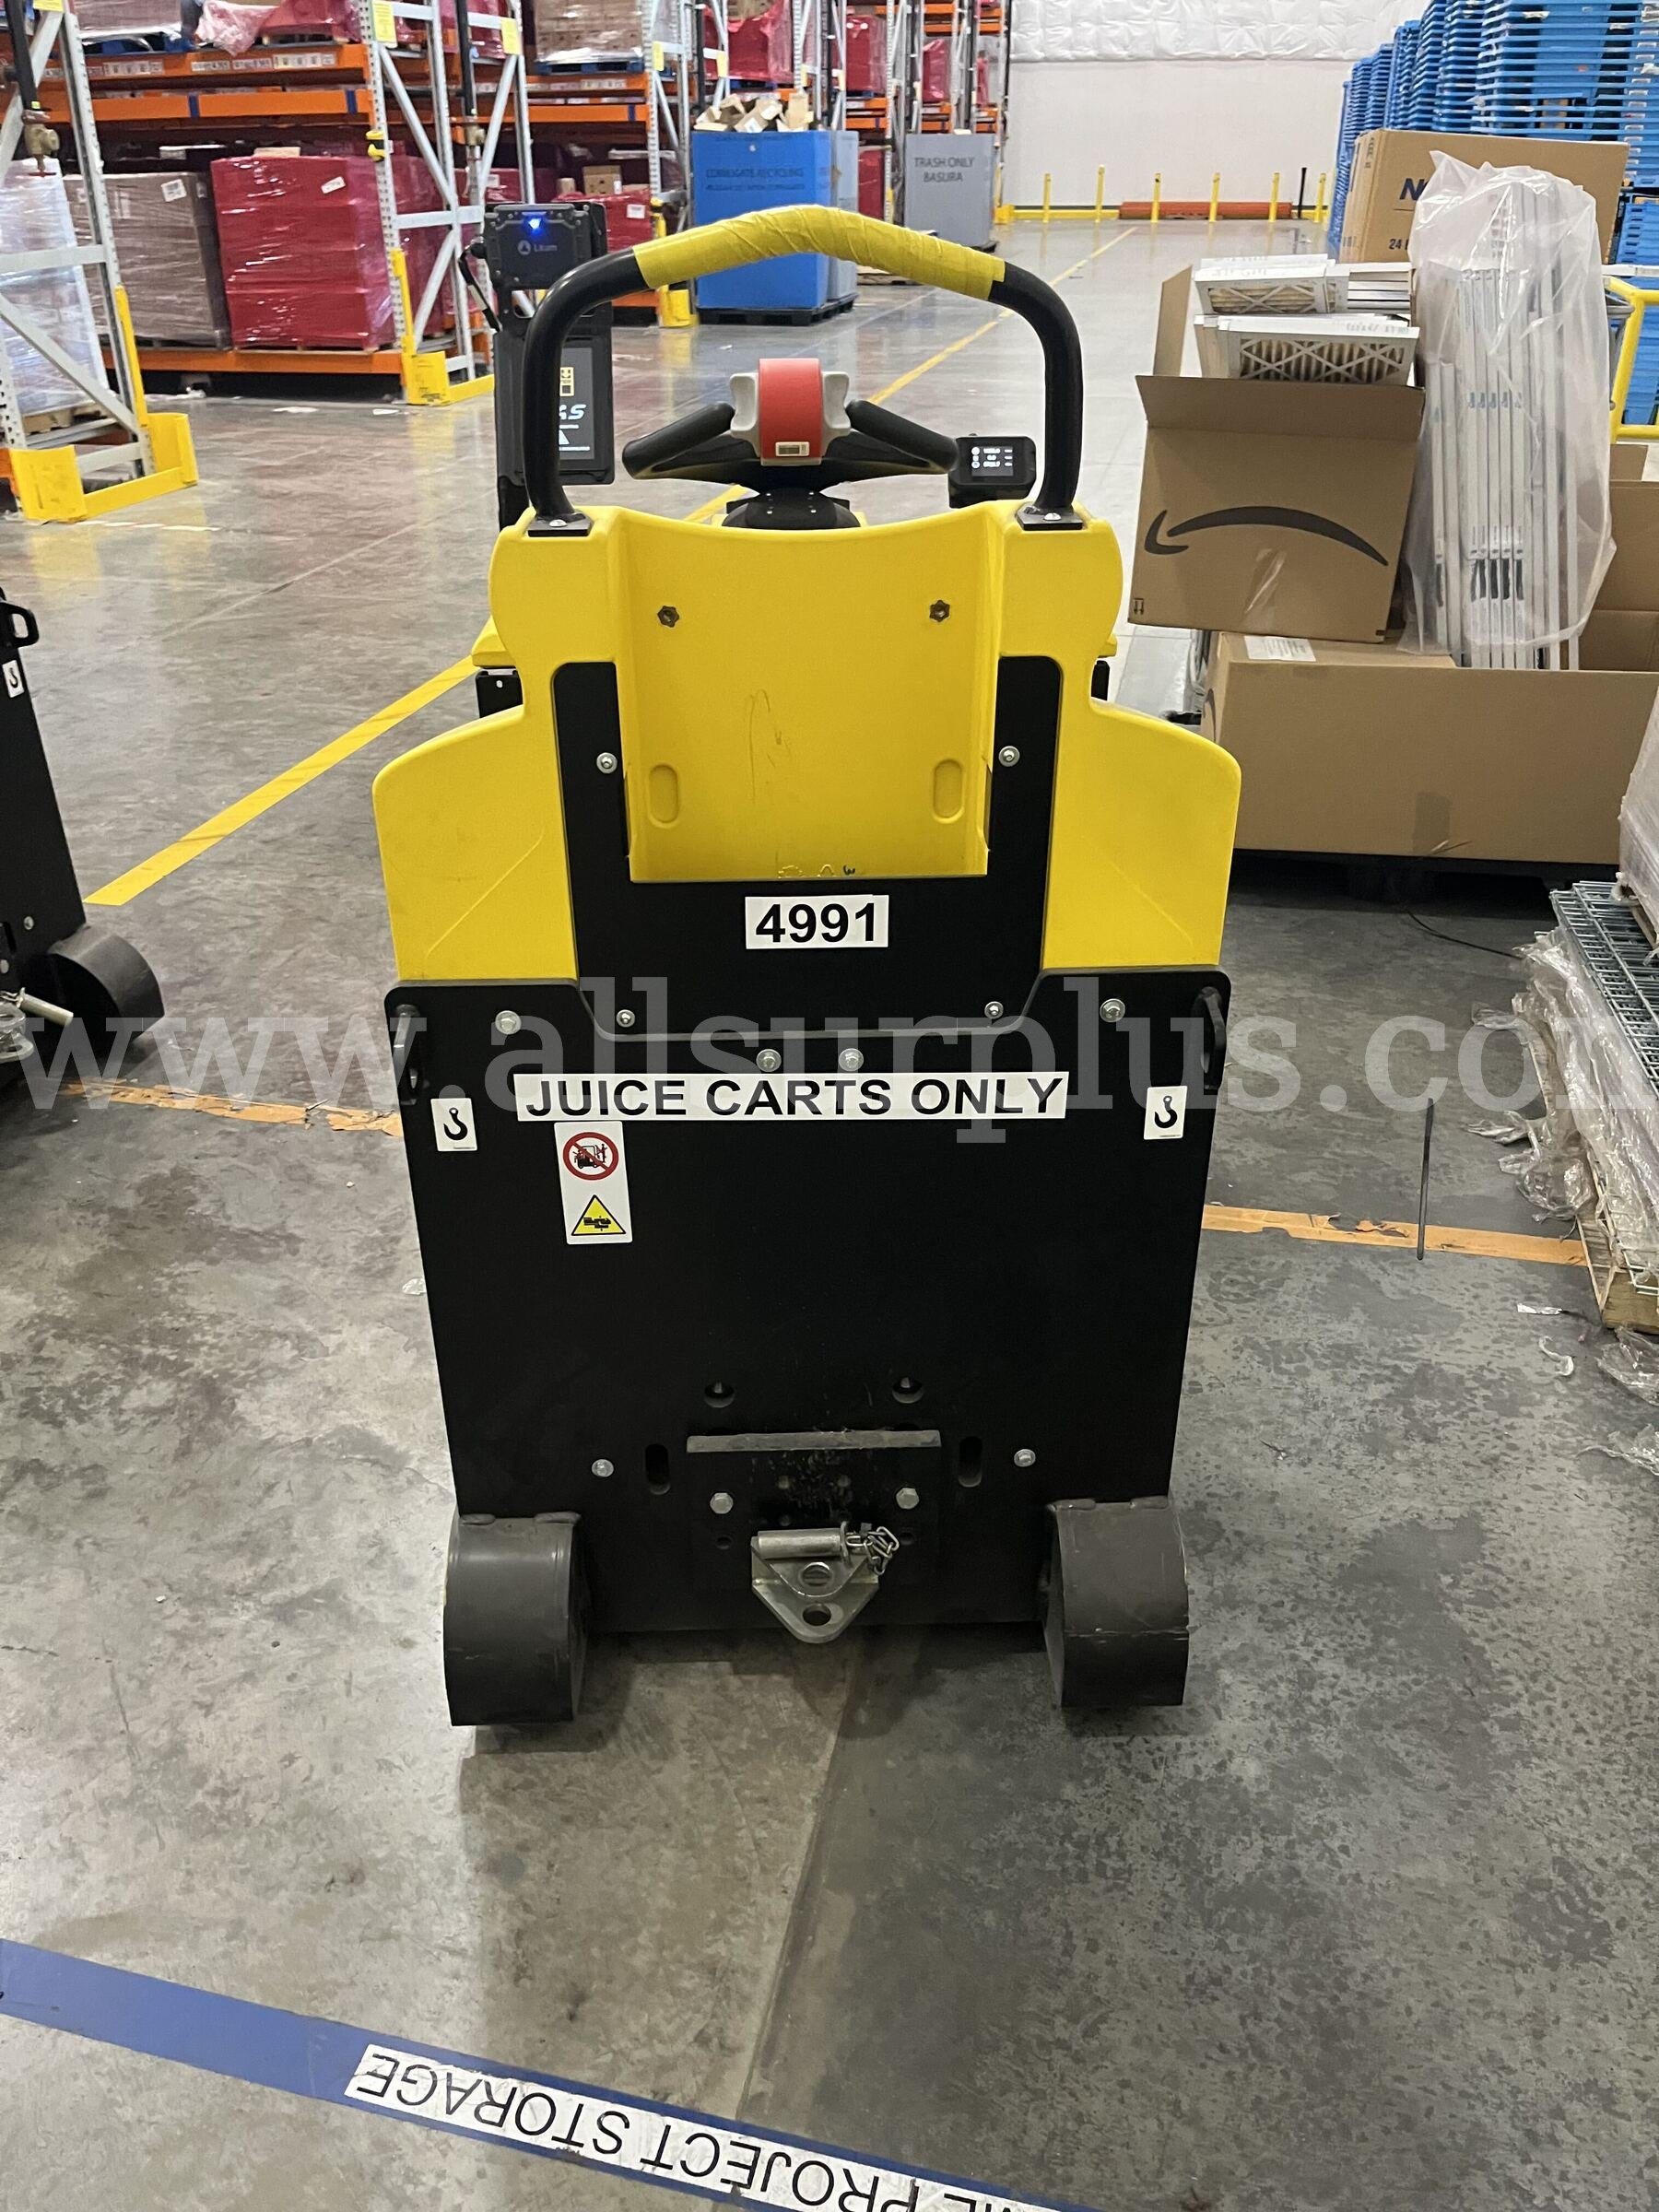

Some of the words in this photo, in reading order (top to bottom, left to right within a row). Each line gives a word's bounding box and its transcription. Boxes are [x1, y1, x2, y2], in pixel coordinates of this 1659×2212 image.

[914, 157, 946, 168] TRASH
[947, 156, 975, 168] ONLY
[1389, 239, 1401, 250] 24
[756, 903, 874, 943] 4991
[525, 1079, 687, 1117] JUICE
[706, 1078, 892, 1116] CARTS
[911, 1077, 1064, 1115] ONLY
[356, 2053, 630, 2155] STORAGE
[640, 2124, 920, 2212] PROJECT
